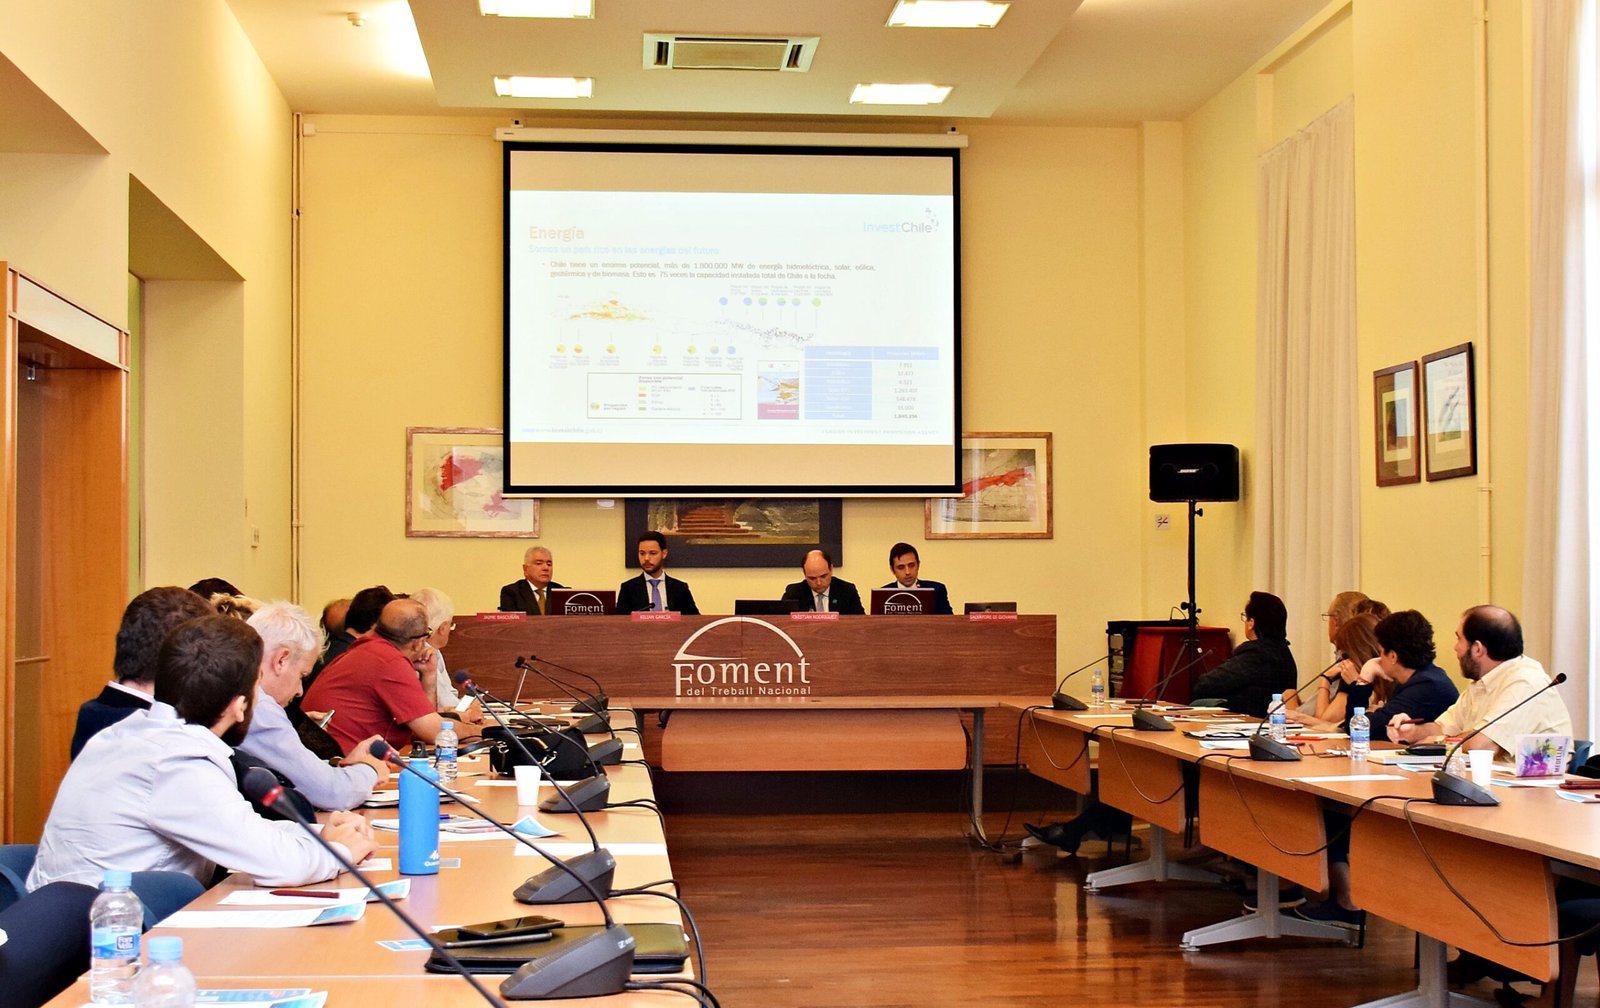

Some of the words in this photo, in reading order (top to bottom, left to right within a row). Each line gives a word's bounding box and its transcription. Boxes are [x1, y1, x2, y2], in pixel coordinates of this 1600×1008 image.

[864, 222, 932, 233] InvestChile
[529, 226, 585, 242] Energía
[564, 604, 604, 615] Foment
[884, 604, 922, 615] Foment
[671, 657, 811, 696] Foment
[687, 686, 704, 696] del
[710, 686, 752, 696] Treball
[758, 686, 811, 696] Nacional
